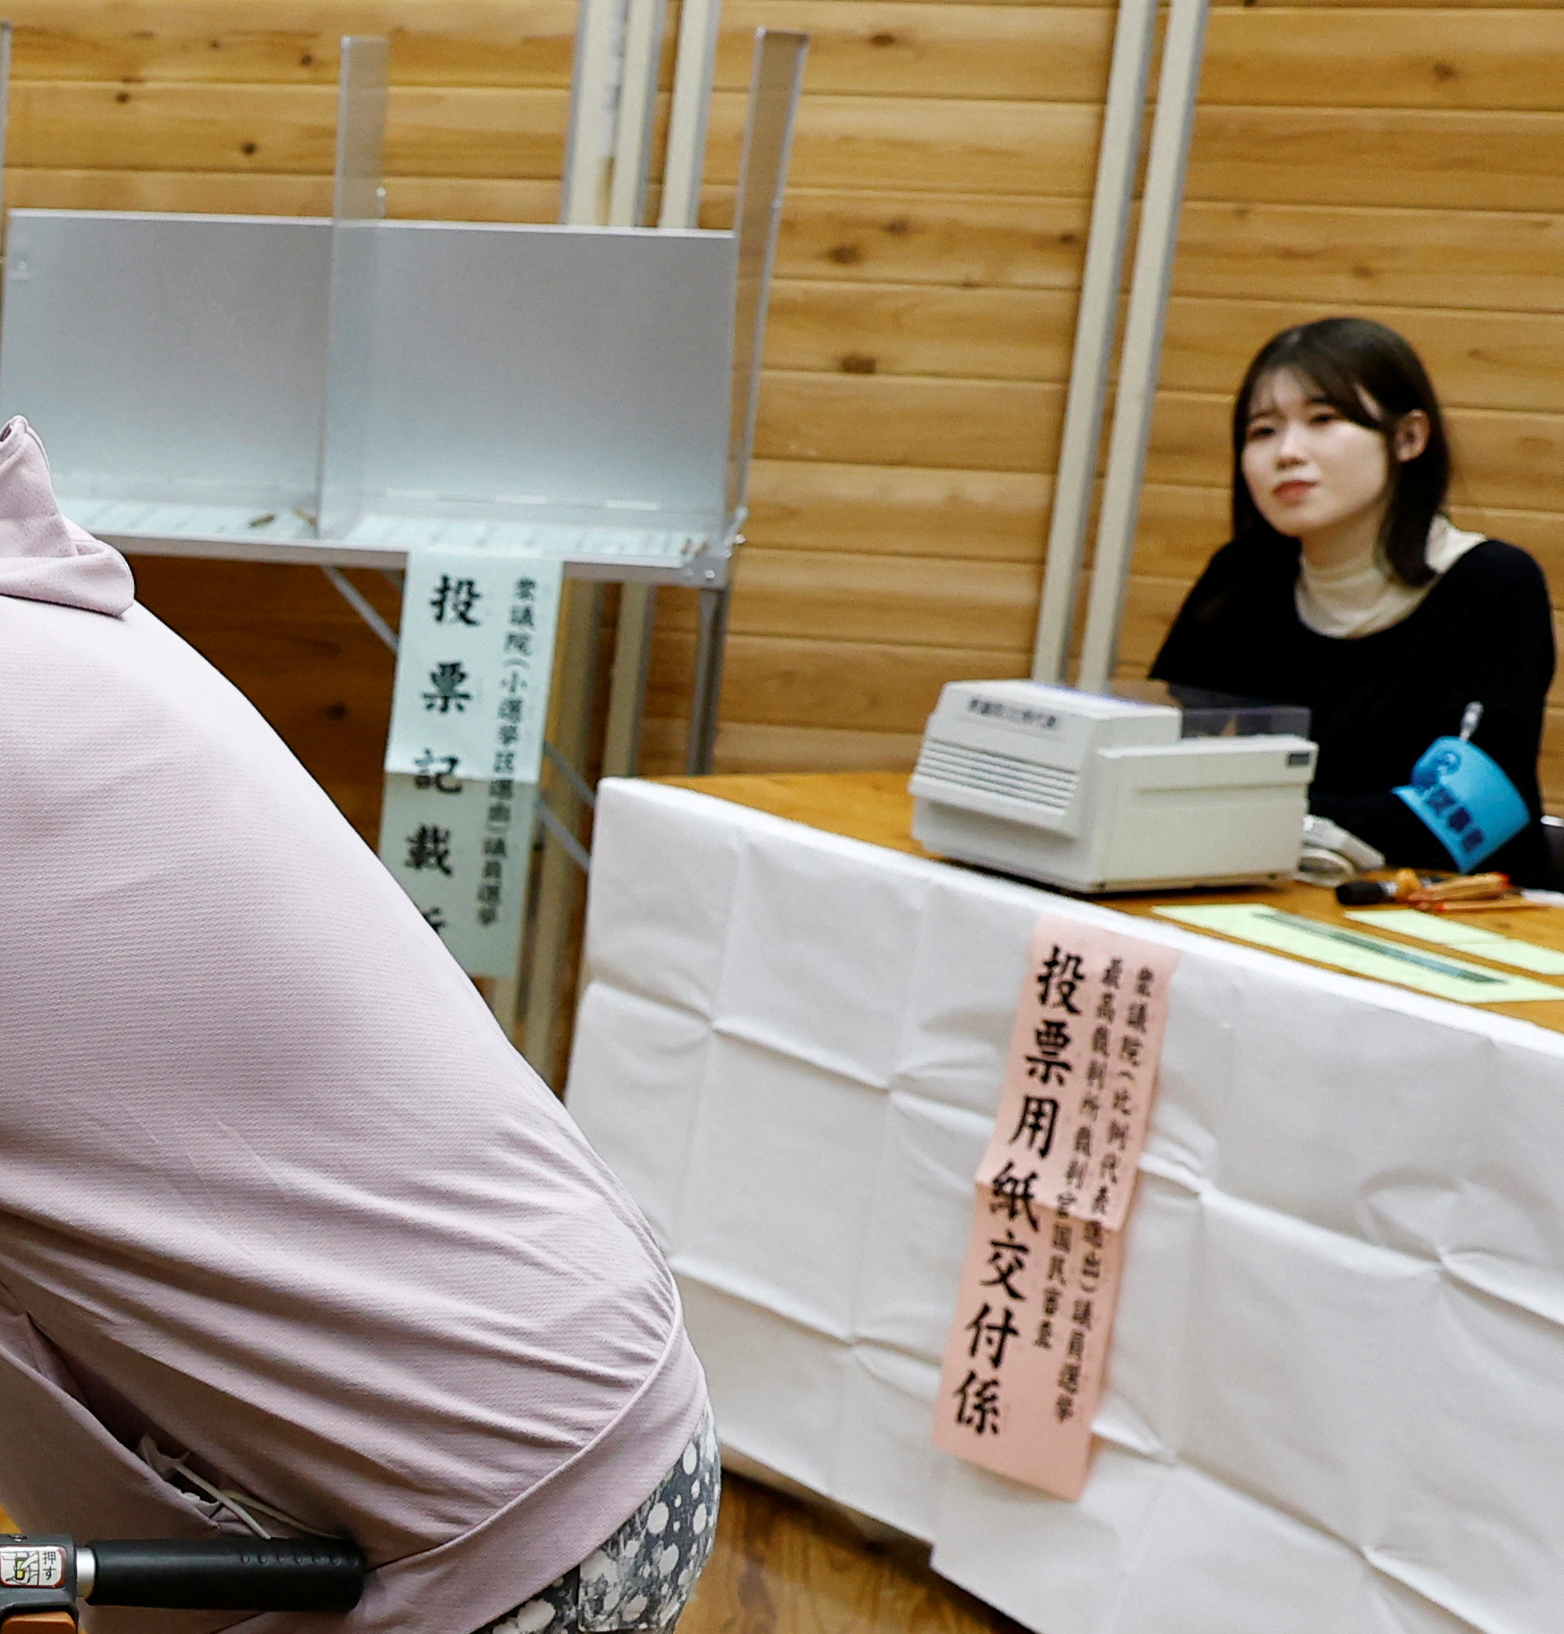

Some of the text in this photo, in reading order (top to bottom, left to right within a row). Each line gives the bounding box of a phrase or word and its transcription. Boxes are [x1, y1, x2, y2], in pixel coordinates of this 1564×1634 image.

[954, 943, 1086, 1437] 投票用紙交付係
[41, 1551, 58, 1581] 押す
